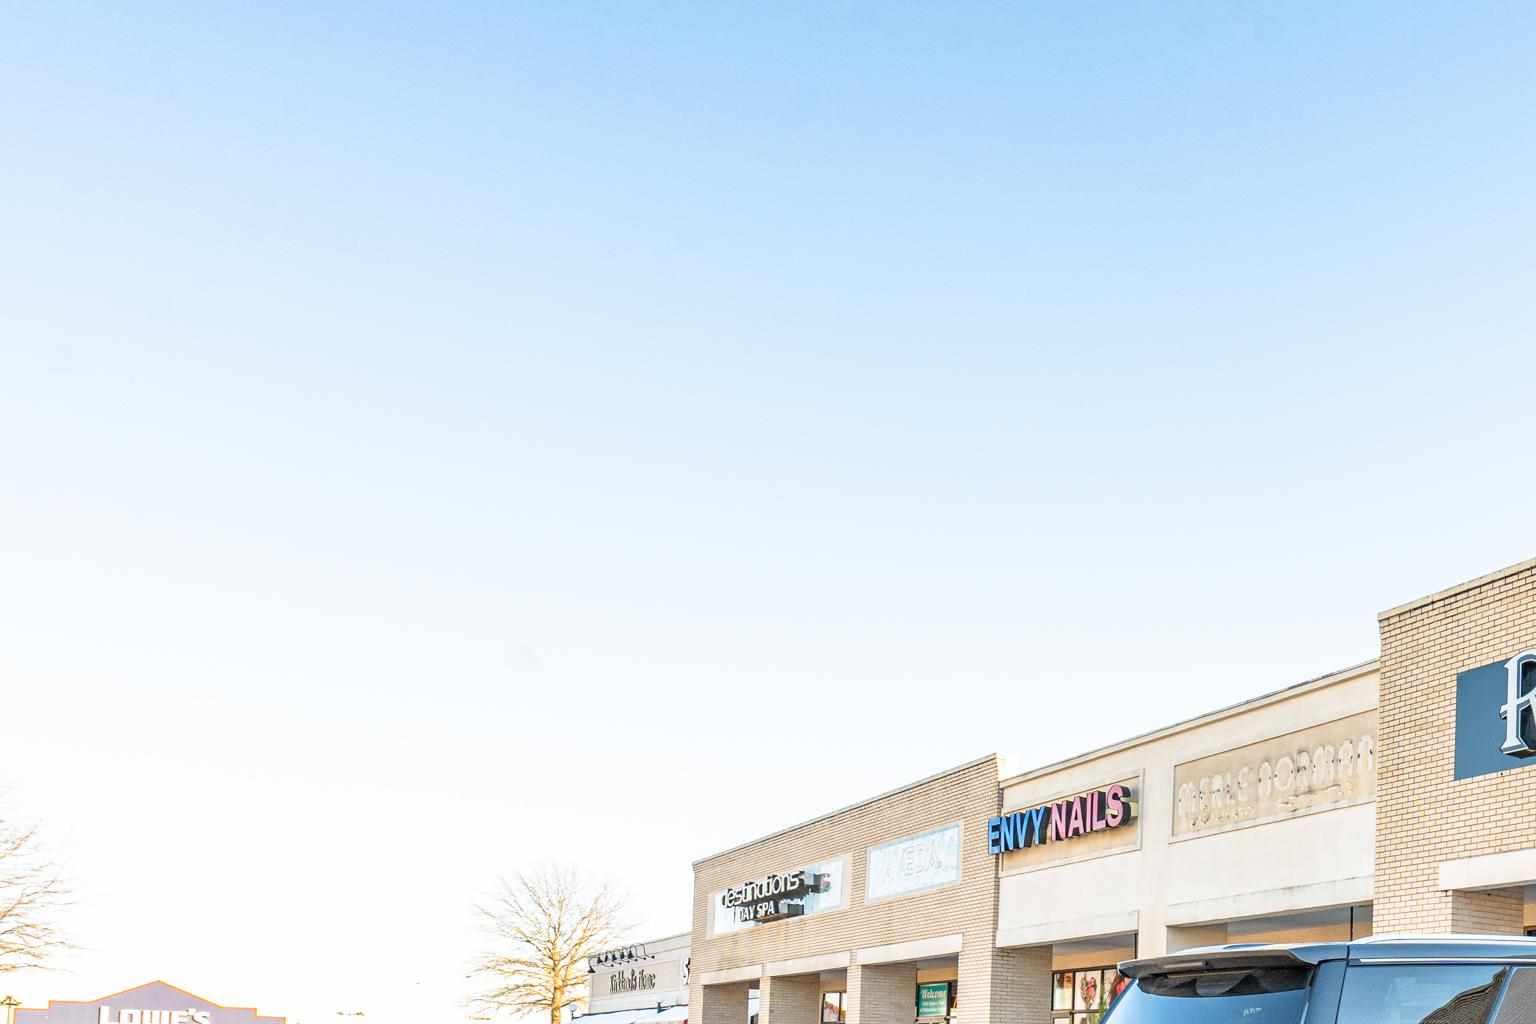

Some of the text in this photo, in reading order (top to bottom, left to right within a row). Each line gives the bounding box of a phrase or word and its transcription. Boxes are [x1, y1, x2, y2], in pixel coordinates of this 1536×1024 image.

[988, 805, 1048, 855] ENVY
[1051, 784, 1126, 841] NAILS
[720, 872, 803, 908] destinations
[738, 901, 775, 921] DAY SPA
